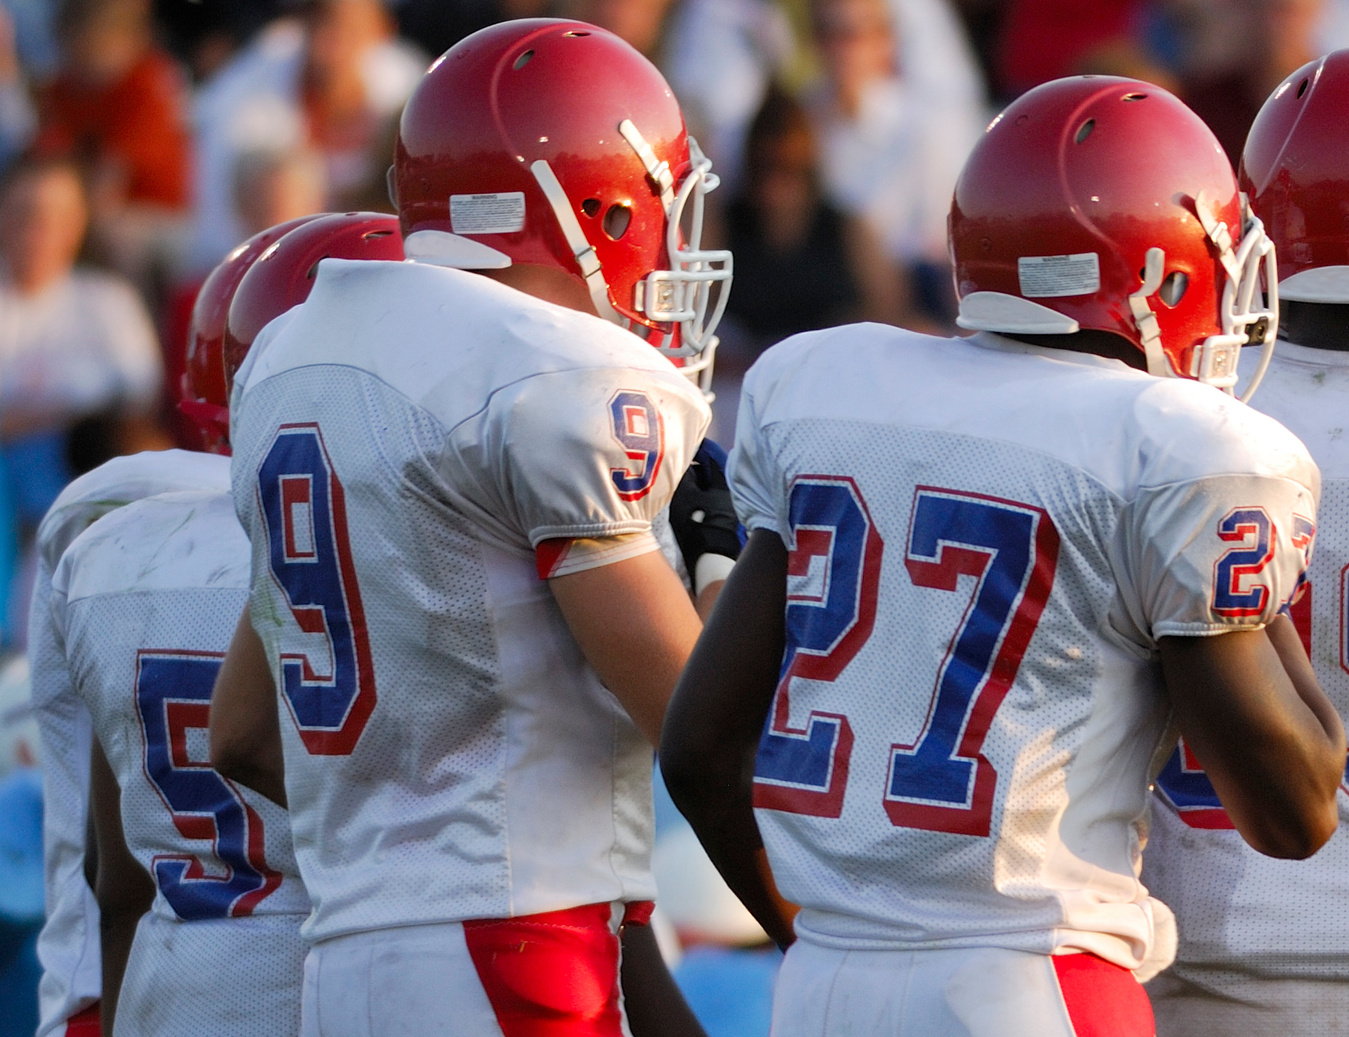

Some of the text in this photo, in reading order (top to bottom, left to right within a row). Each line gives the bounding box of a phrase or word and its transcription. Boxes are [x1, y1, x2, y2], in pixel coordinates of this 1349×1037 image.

[256, 422, 377, 755] 9
[608, 390, 664, 502] 9
[753, 474, 1060, 837] 27
